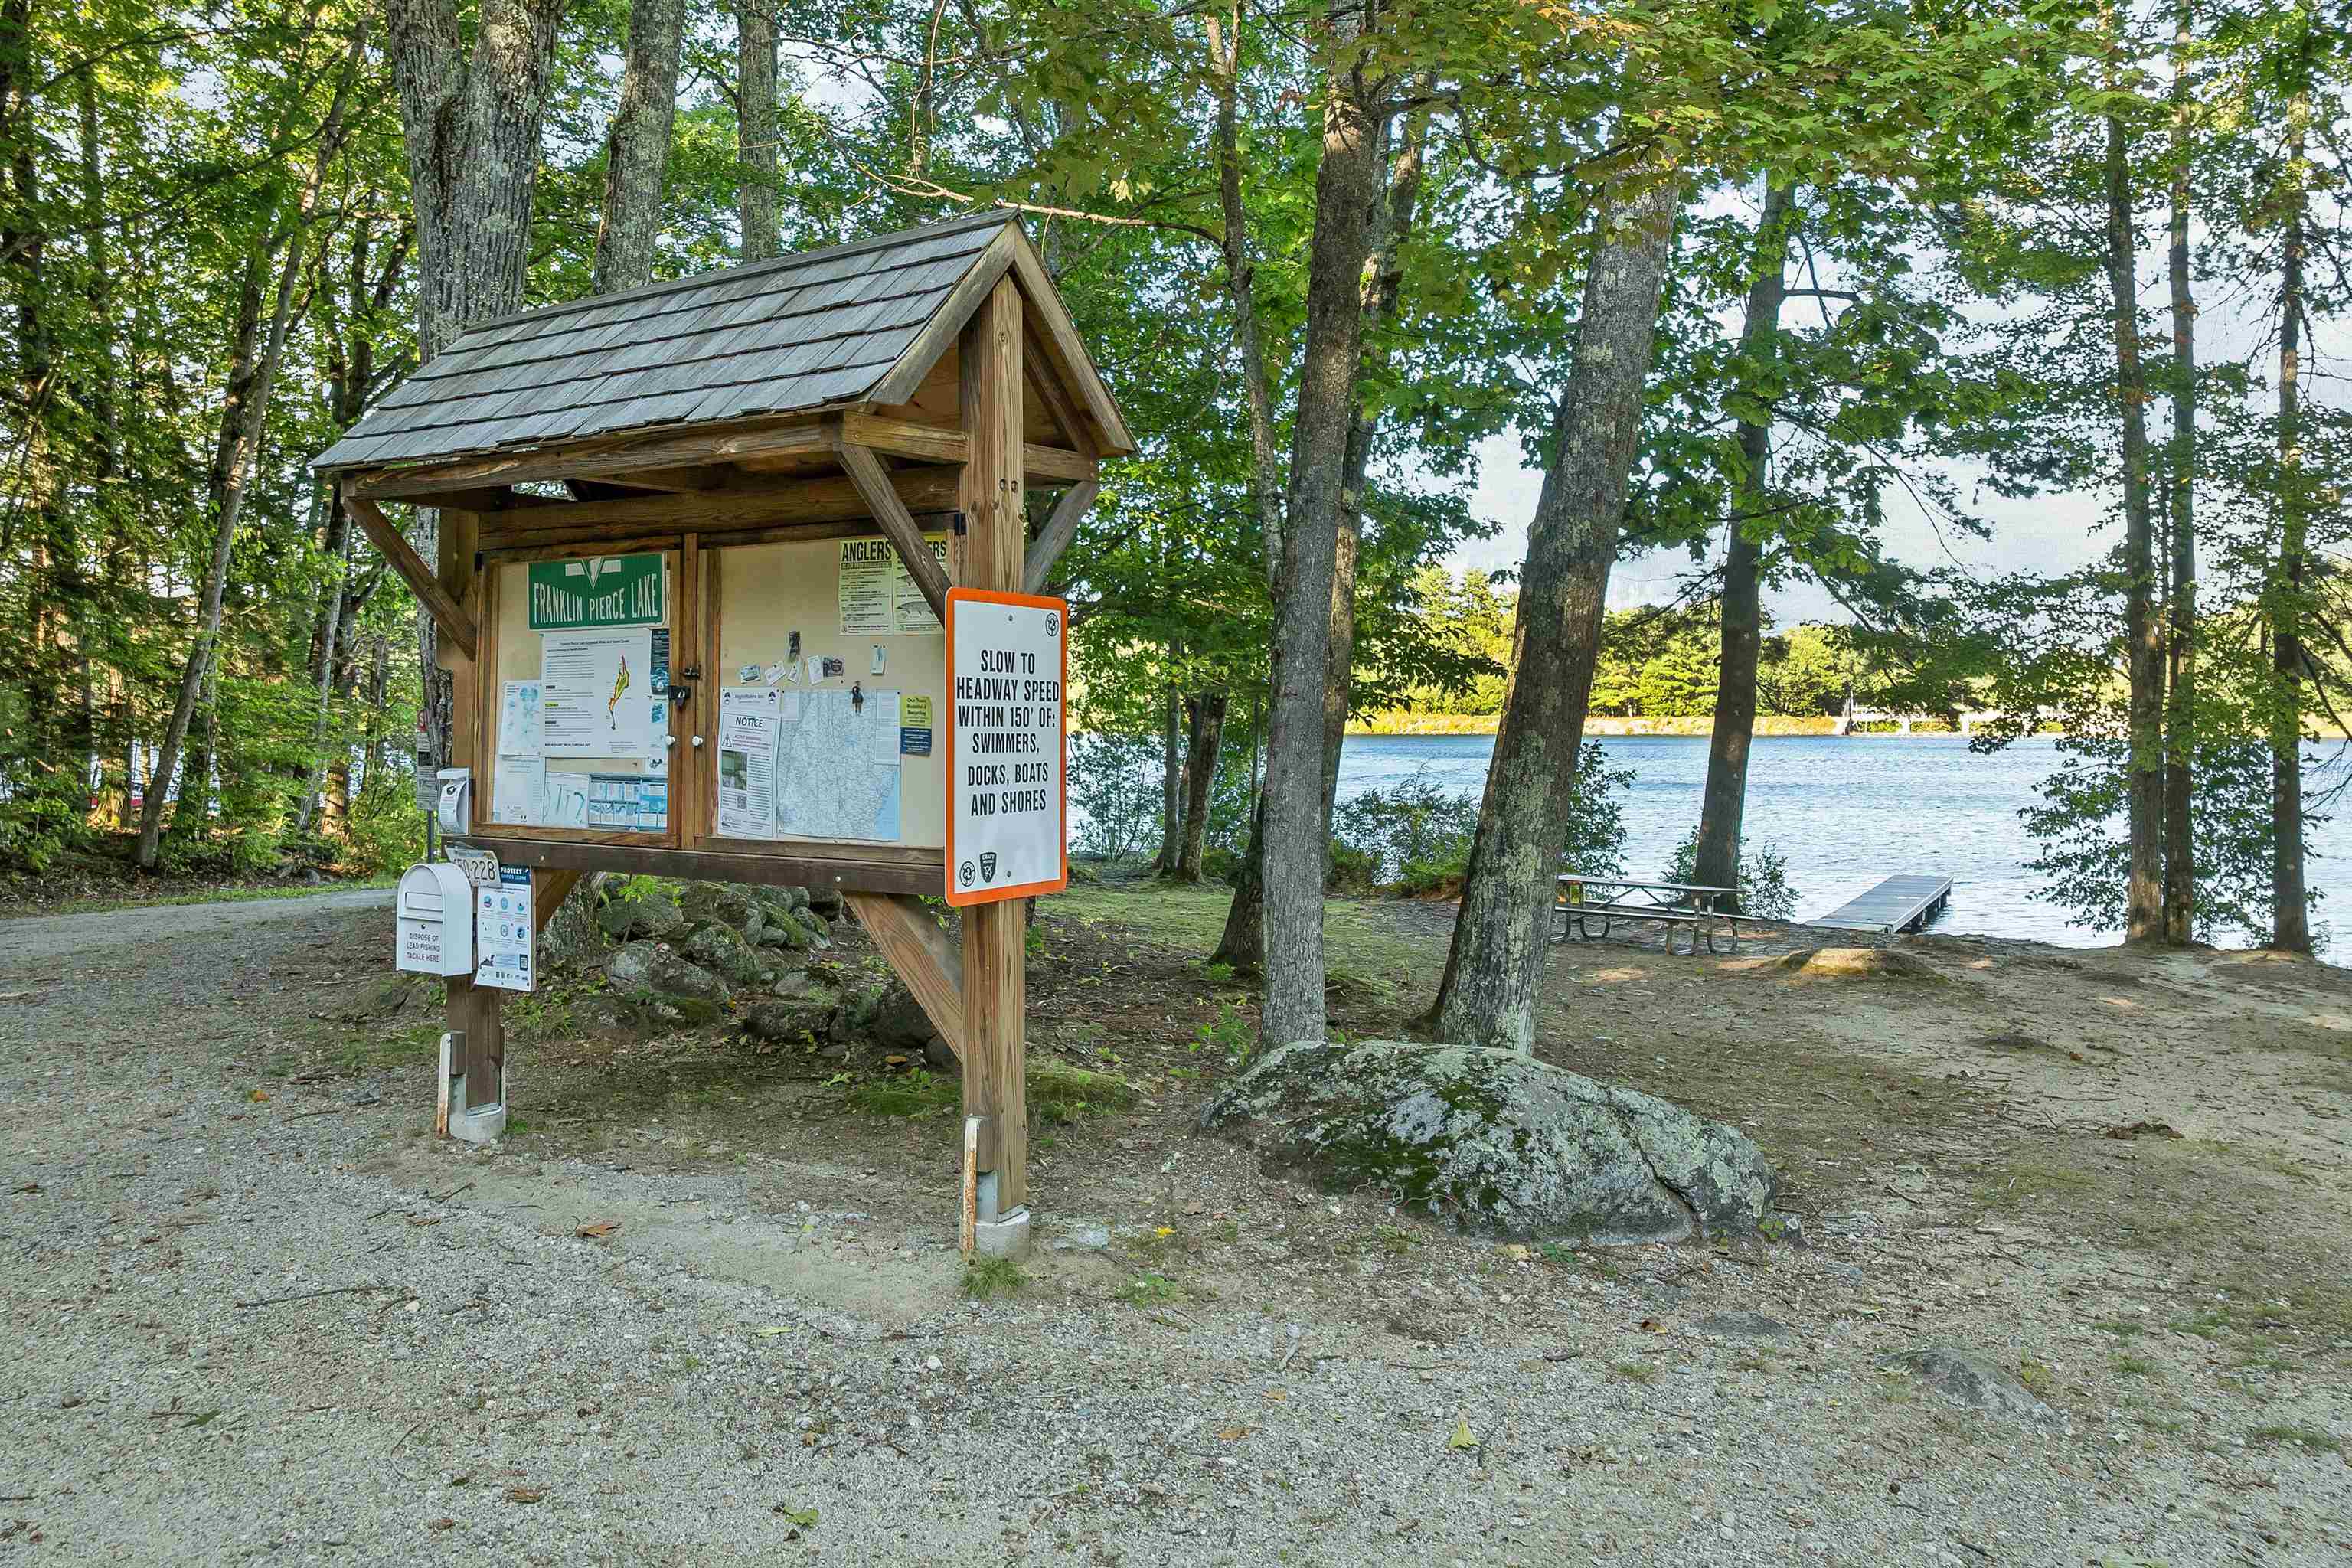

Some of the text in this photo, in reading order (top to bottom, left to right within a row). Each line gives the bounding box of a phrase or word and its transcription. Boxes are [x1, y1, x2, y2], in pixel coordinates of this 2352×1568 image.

[842, 541, 892, 561] ANGLERS
[534, 573, 658, 623] FRANKLIN PIERCE LAKE
[980, 649, 1035, 675] SLOW TO
[956, 677, 1059, 702] HEADWAY SPEED
[735, 716, 763, 728] NOTICE
[958, 705, 1055, 727] WITHIN 150' OF:
[972, 733, 1040, 754] SWIMMERS,
[968, 762, 1048, 786] DOCKS, BOATS
[970, 789, 1046, 816] AND SHORES
[410, 933, 430, 942] DISPOSE
[420, 943, 440, 952] FISHING
[407, 952, 426, 961] TACKLE
